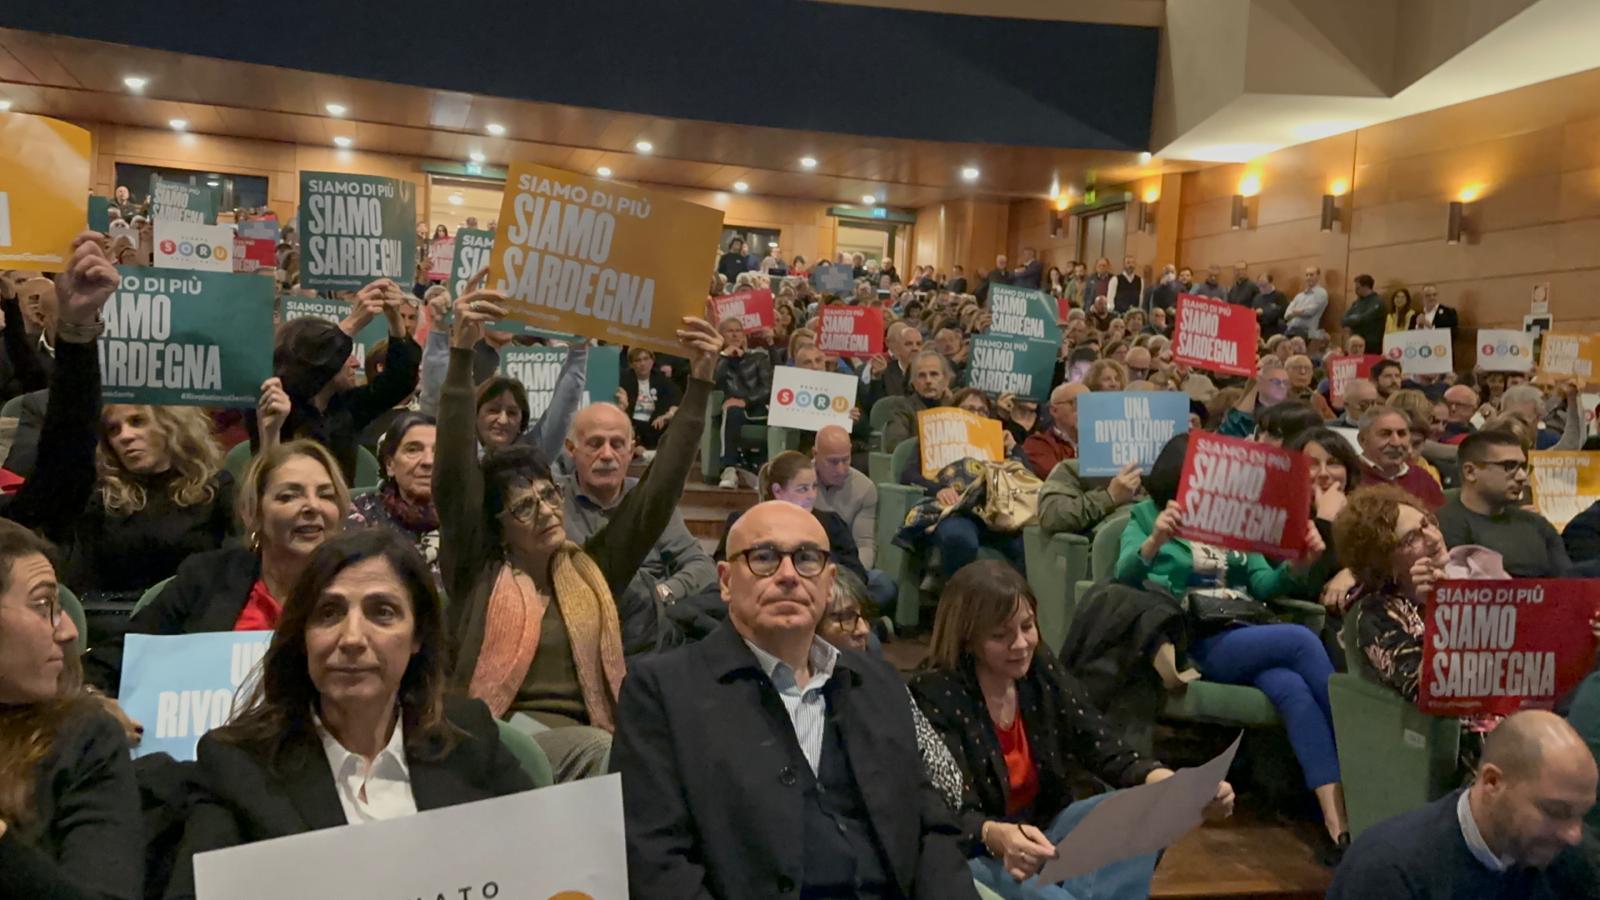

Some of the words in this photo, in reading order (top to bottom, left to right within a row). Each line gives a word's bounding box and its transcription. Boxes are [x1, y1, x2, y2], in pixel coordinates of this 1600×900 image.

[308, 180, 360, 195] SIAMO
[362, 183, 376, 196] DI
[378, 183, 394, 199] PIÙ
[518, 174, 588, 203] SIAMO
[591, 190, 612, 210] DI
[616, 196, 650, 219] PIÙ
[308, 194, 383, 237] SIAMO
[507, 193, 615, 264] SIAMO
[162, 241, 227, 260] SORU
[308, 235, 402, 277] SARDEGNA
[144, 278, 165, 293] DI
[169, 276, 202, 295] PIÙ
[496, 246, 655, 329] SARDEGNA
[101, 292, 171, 341] AMO
[286, 301, 324, 313] SIAMO
[325, 305, 336, 314] DI
[992, 294, 1027, 317] SIAMO
[1183, 299, 1208, 312] SIAMO
[1209, 304, 1217, 313] DI
[822, 316, 854, 334] SIAMO
[990, 312, 1045, 339] SARDEGNA
[1180, 307, 1219, 338] SIAMO
[506, 352, 544, 362] SIAMO
[545, 353, 558, 361] DI
[975, 339, 1002, 349] SIAMO
[1003, 342, 1012, 350] DI
[1014, 342, 1028, 352] PIÙ
[1176, 331, 1237, 366] SARDEGNA
[971, 347, 1014, 372] SIAMO
[969, 368, 1032, 396] SARDEGNA
[779, 389, 848, 412] SORU
[1124, 397, 1152, 419] UNA
[1197, 438, 1249, 459] SIAMO
[1249, 449, 1265, 465] DI
[1189, 452, 1266, 503] SIAMO
[1182, 489, 1287, 545] SARDEGNA
[1436, 588, 1492, 603] SIAMO
[1495, 588, 1513, 603] DI
[1517, 584, 1544, 604] PIÙ
[1433, 604, 1516, 650] SIAMO
[1430, 651, 1556, 697] SARDEGNA
